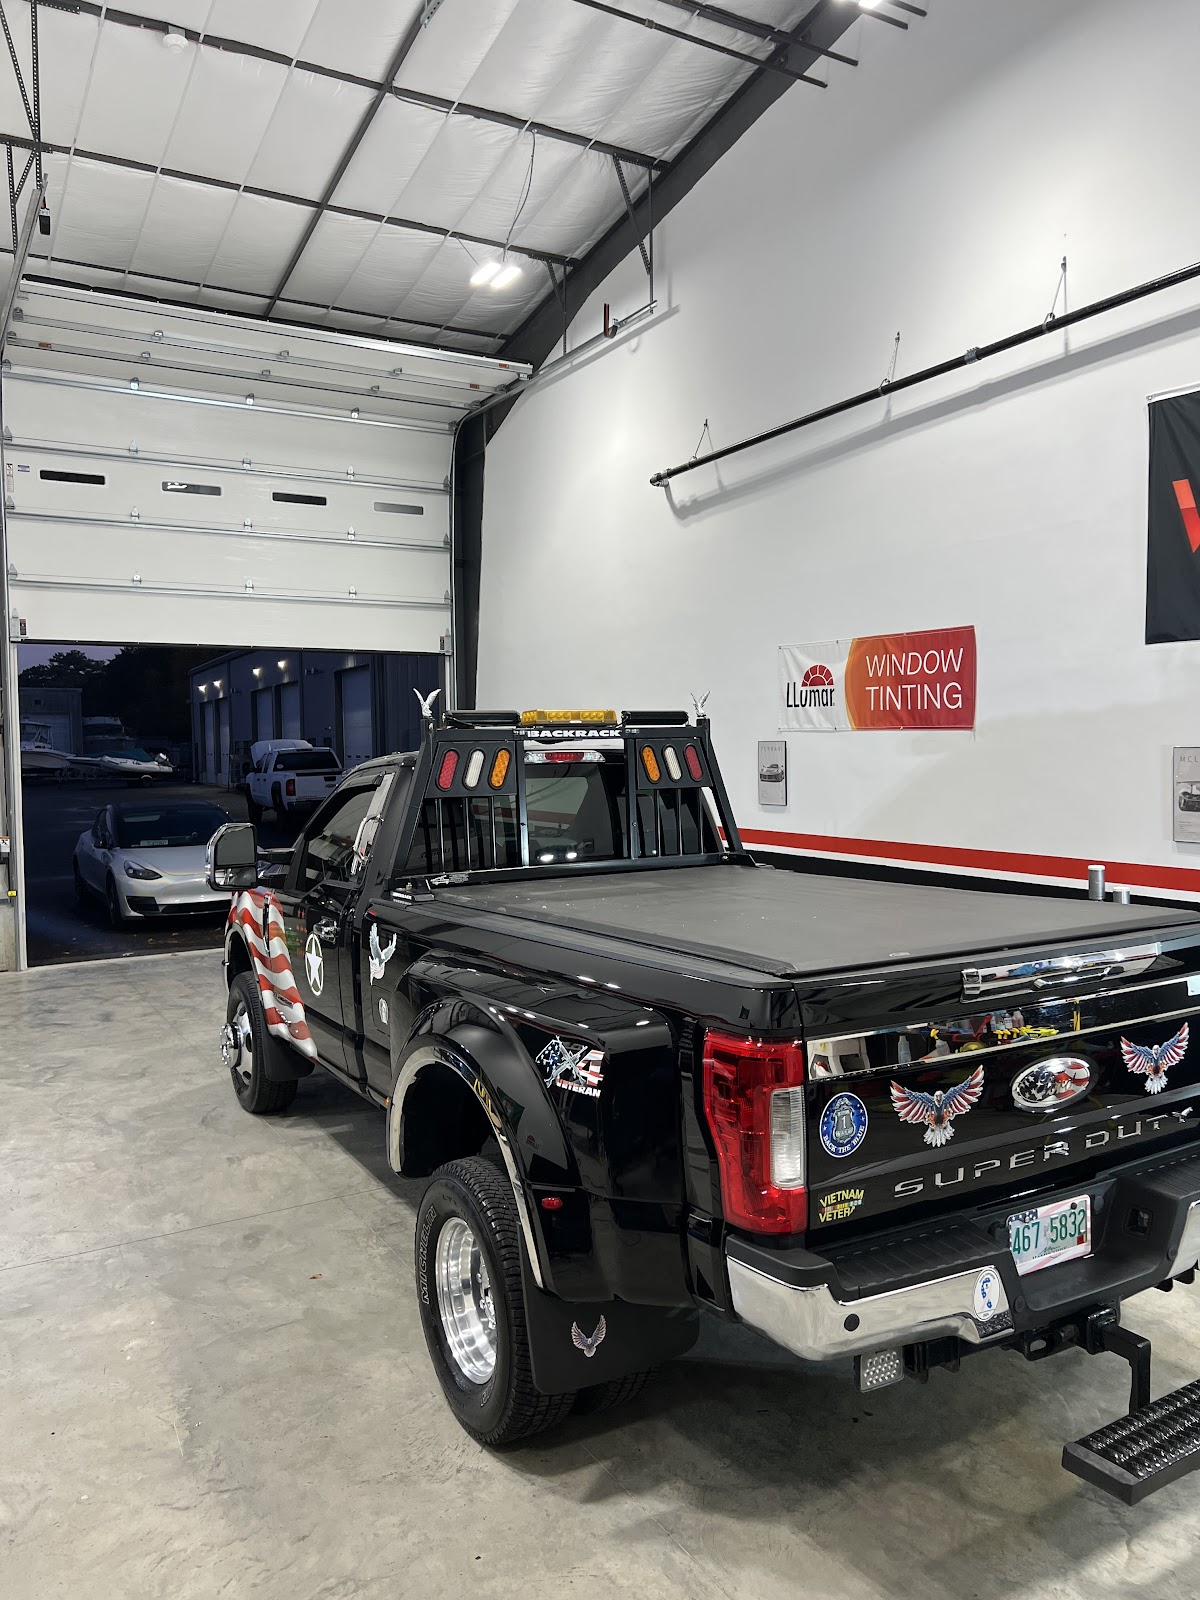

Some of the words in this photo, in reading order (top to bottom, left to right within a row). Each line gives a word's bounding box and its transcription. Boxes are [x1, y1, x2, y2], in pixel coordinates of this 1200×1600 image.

[865, 647, 964, 678] WINDOW
[786, 682, 835, 708] LLumar
[865, 682, 963, 711] TINTING
[527, 729, 621, 738] BACKRACK
[556, 1079, 602, 1099] VETERAN
[823, 1133, 838, 1153] BACK
[838, 1145, 851, 1153] THE
[851, 1125, 865, 1147] BLUE
[894, 1141, 1070, 1198] SUPER
[1085, 1106, 1194, 1149] DUTY
[819, 1188, 865, 1207] VIETNAM
[1012, 1221, 1041, 1254] 467
[1050, 1208, 1086, 1243] 5832
[419, 1204, 438, 1305] MICHELIN
